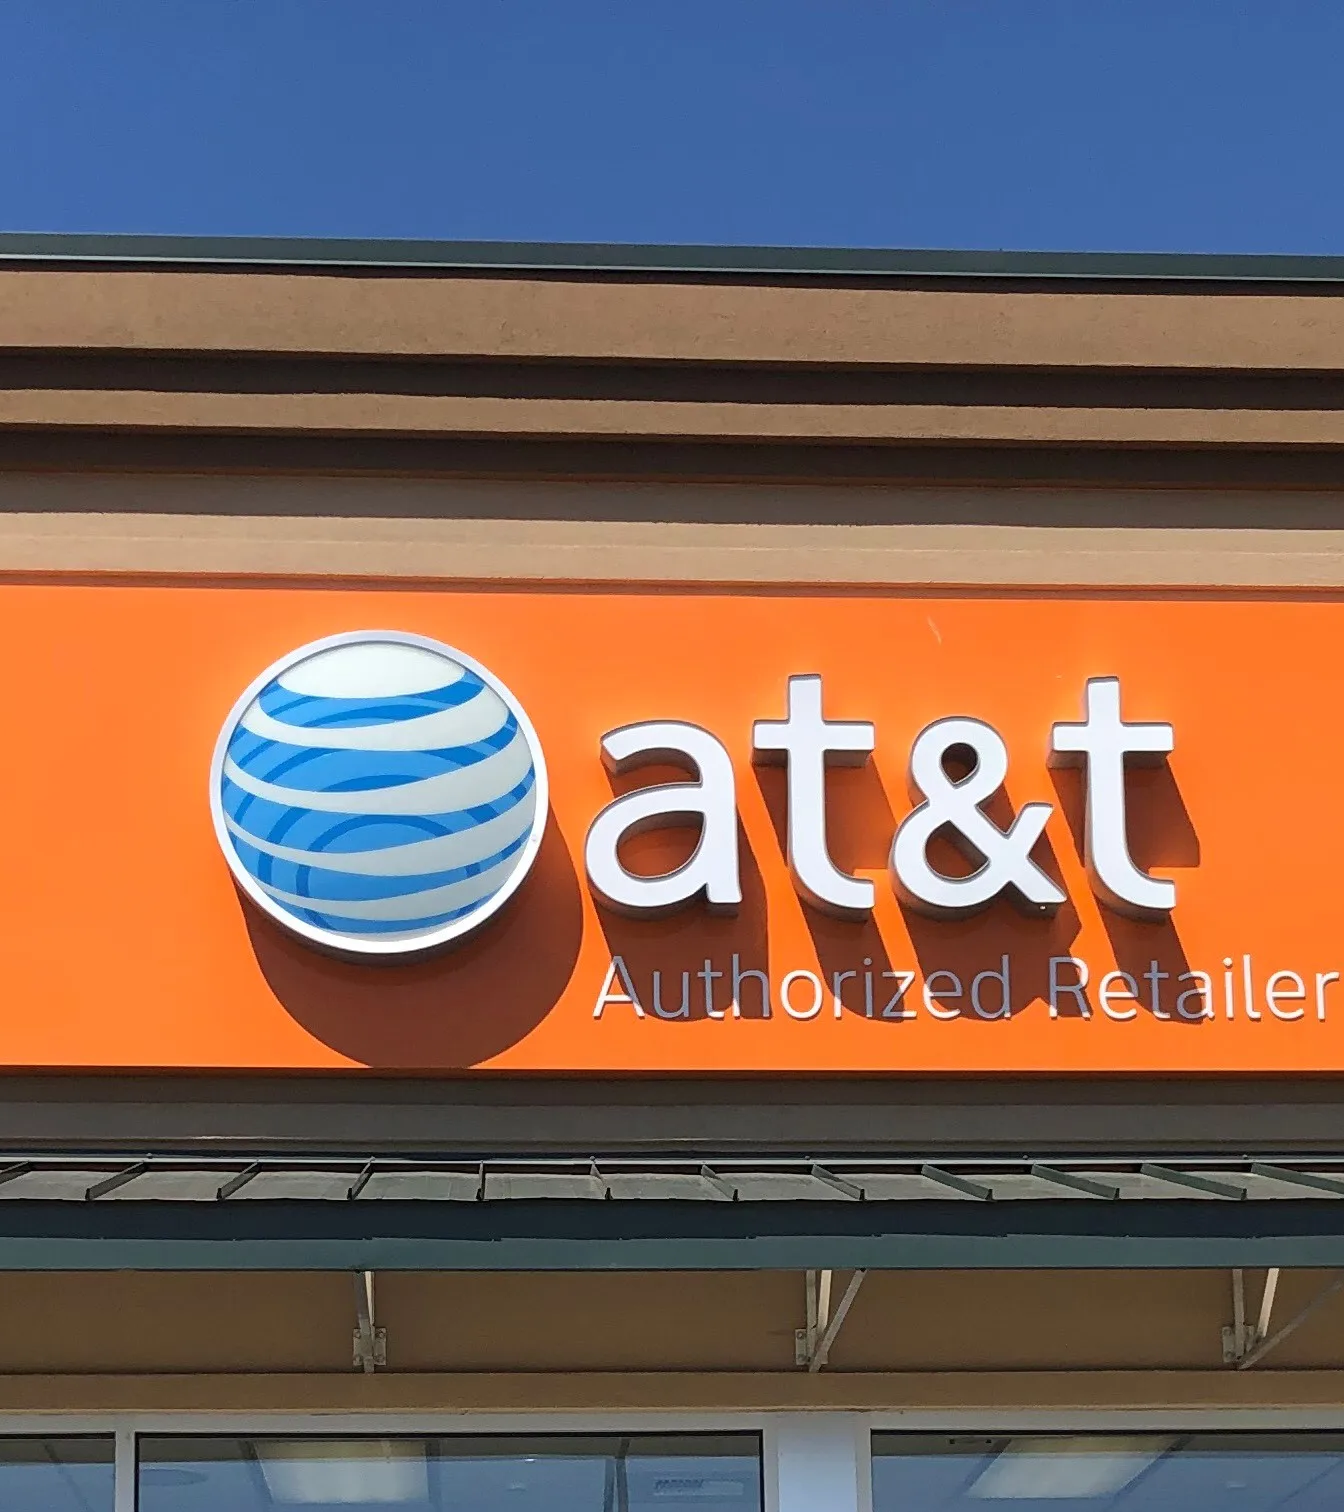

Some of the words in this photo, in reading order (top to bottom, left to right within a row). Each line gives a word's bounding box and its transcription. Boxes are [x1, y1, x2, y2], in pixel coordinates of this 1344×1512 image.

[583, 673, 1176, 924] at&t
[591, 954, 1013, 1021] Authorized
[1048, 954, 1341, 1022] Retailer
